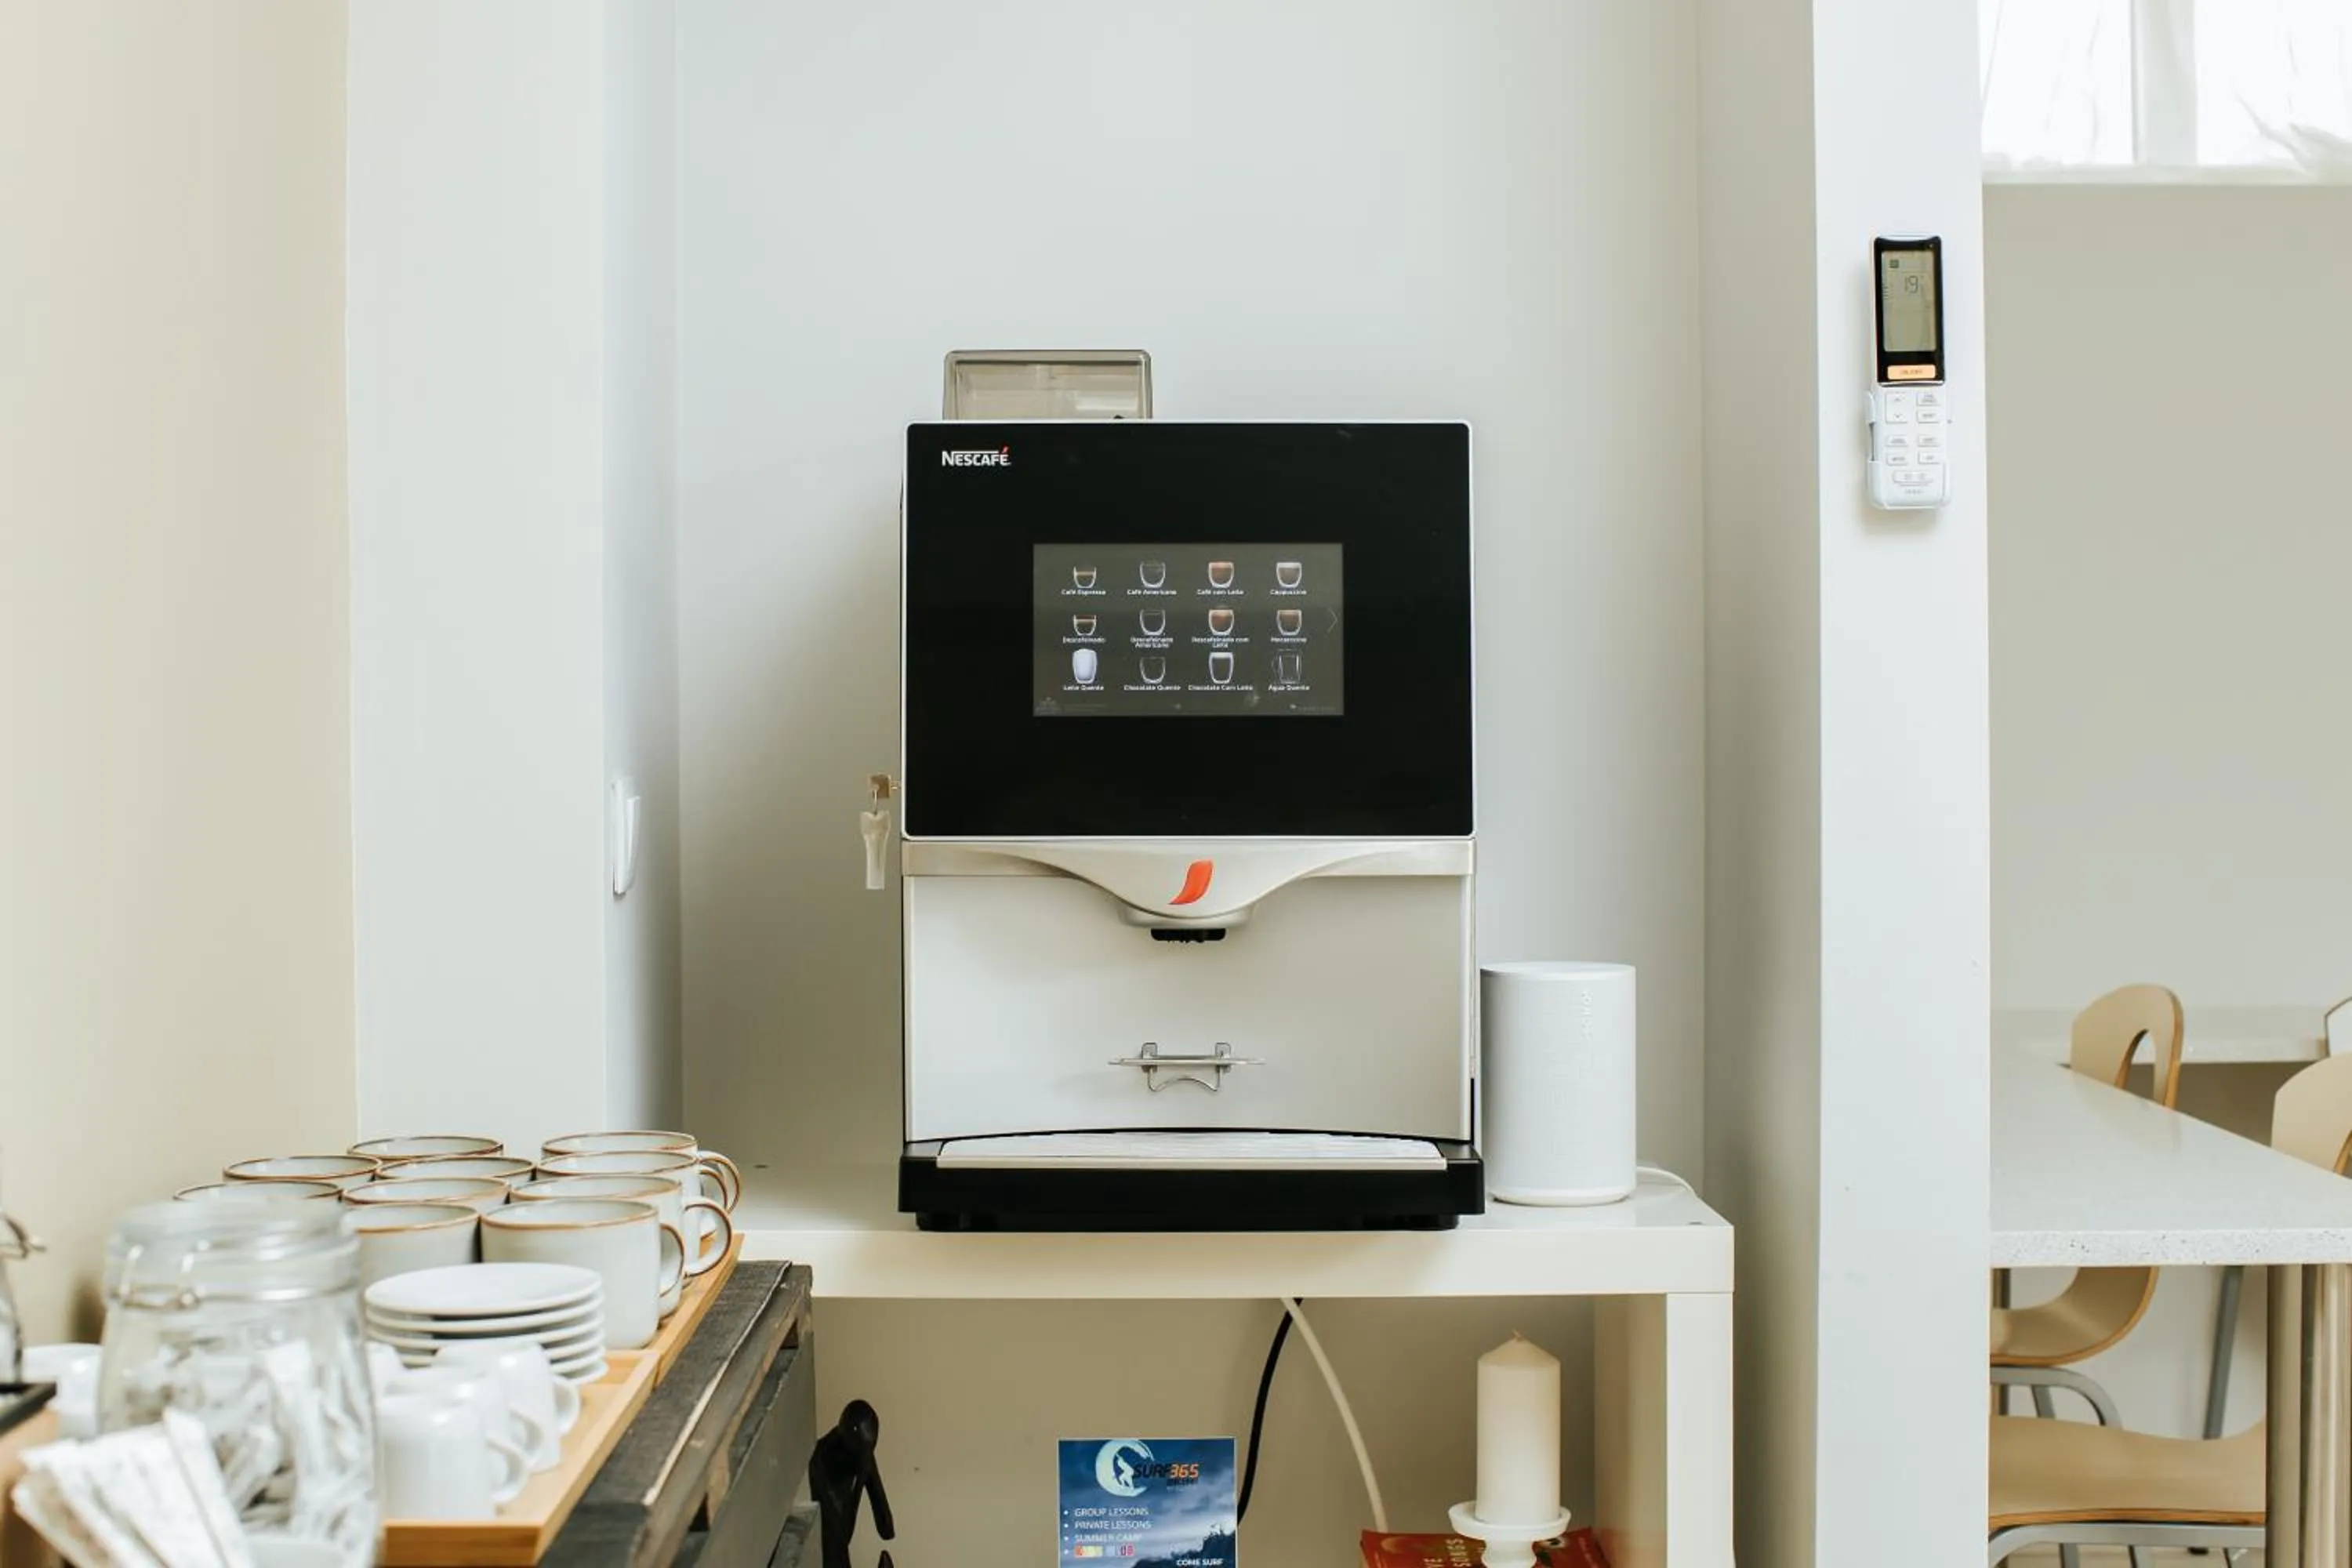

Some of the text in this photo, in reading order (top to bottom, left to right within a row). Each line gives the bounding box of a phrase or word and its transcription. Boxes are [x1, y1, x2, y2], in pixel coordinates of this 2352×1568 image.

[942, 445, 1011, 466] NESCAFÉ
[1074, 1507, 1149, 1517] GROUP LESSONS
[1074, 1519, 1152, 1530] PRIVATE LESSONS
[1202, 1557, 1225, 1566] SURF
